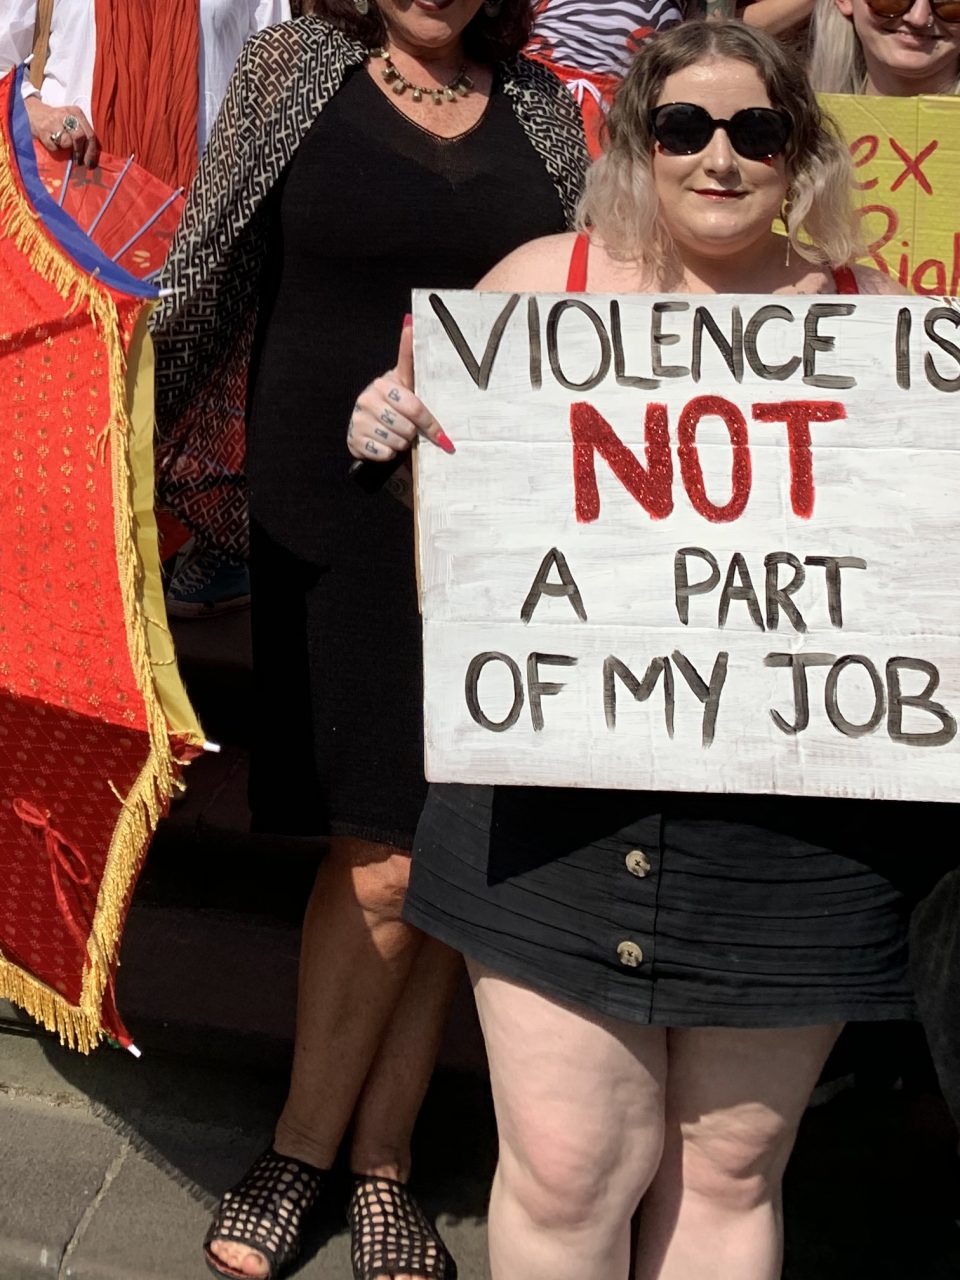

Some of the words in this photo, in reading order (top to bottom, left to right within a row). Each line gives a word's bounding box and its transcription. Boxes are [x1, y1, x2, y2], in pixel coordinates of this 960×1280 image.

[429, 292, 857, 391] VIOLENCE
[895, 306, 960, 394] IS
[569, 394, 848, 524] NOT
[520, 547, 588, 625] A
[674, 547, 868, 633] PART
[465, 650, 579, 733] OF
[603, 649, 730, 749] MY
[763, 651, 958, 747] JOB
